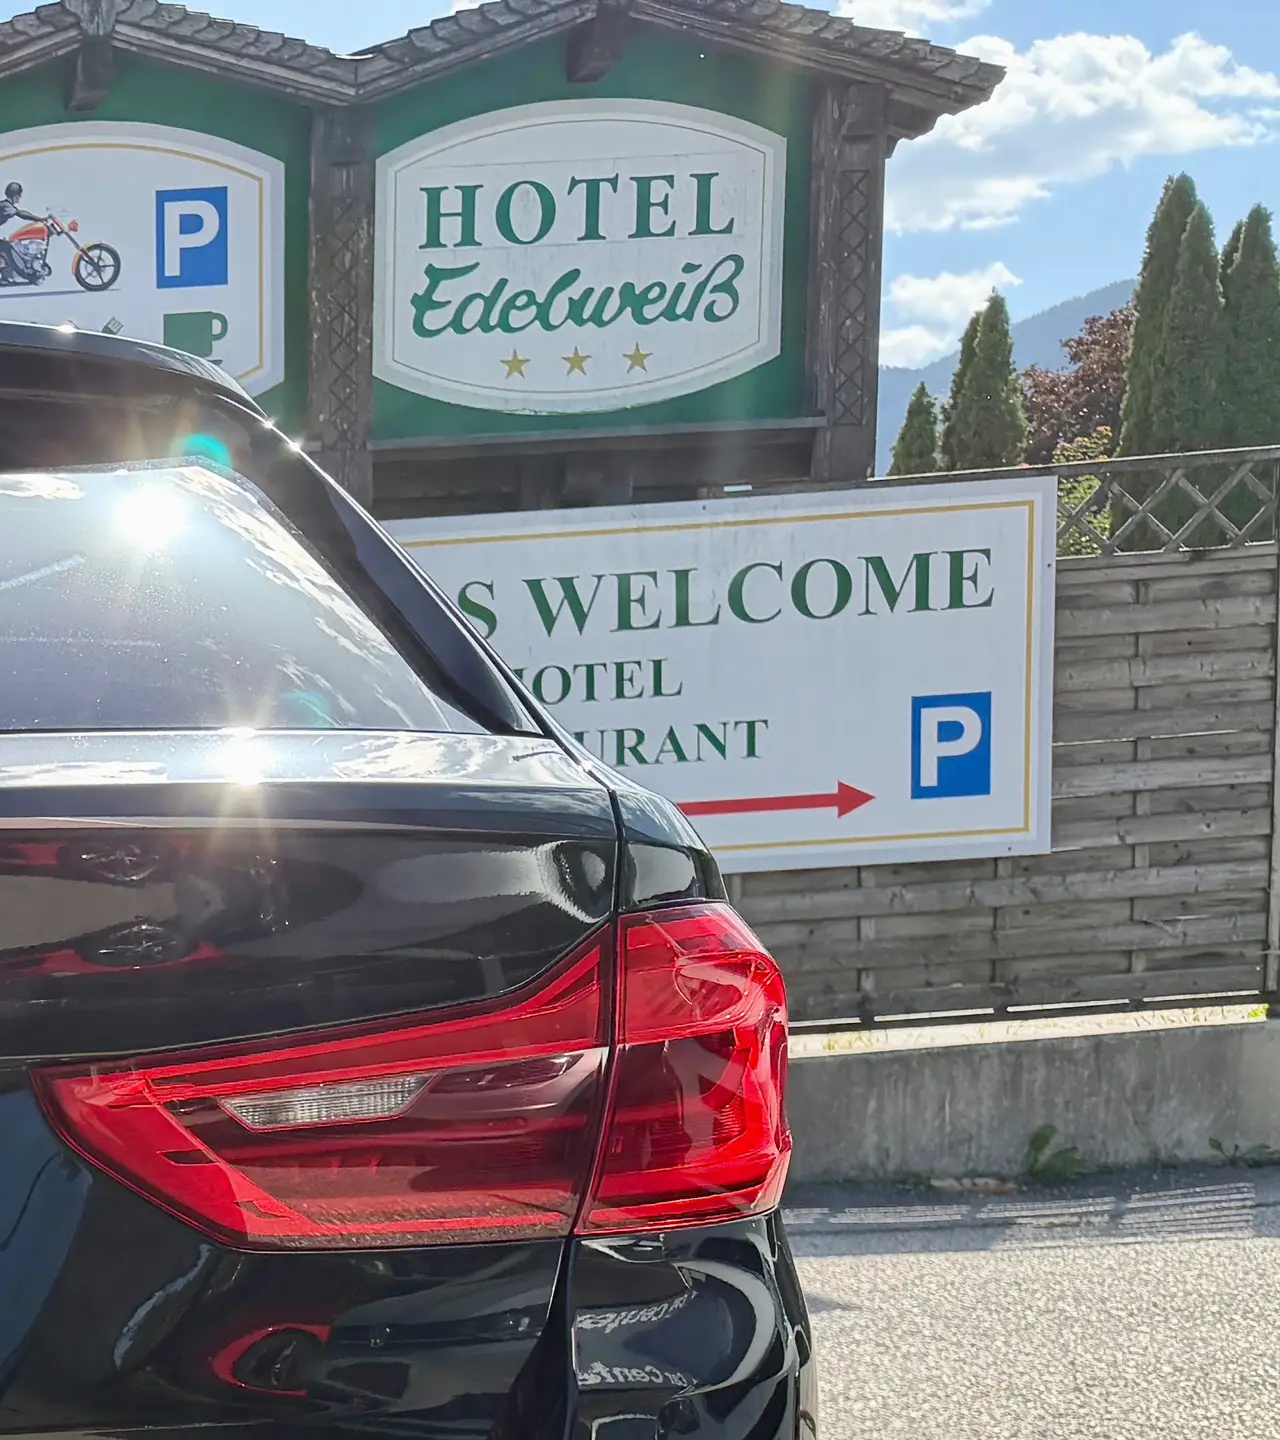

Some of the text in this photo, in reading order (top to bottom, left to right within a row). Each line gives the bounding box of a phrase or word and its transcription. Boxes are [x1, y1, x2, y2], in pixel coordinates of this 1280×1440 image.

[163, 201, 220, 277] P
[418, 171, 736, 251] HOTEL
[411, 252, 745, 339] Edelweiß
[522, 547, 995, 639] WELCOME
[512, 656, 685, 705] OTEL
[920, 706, 982, 787] P
